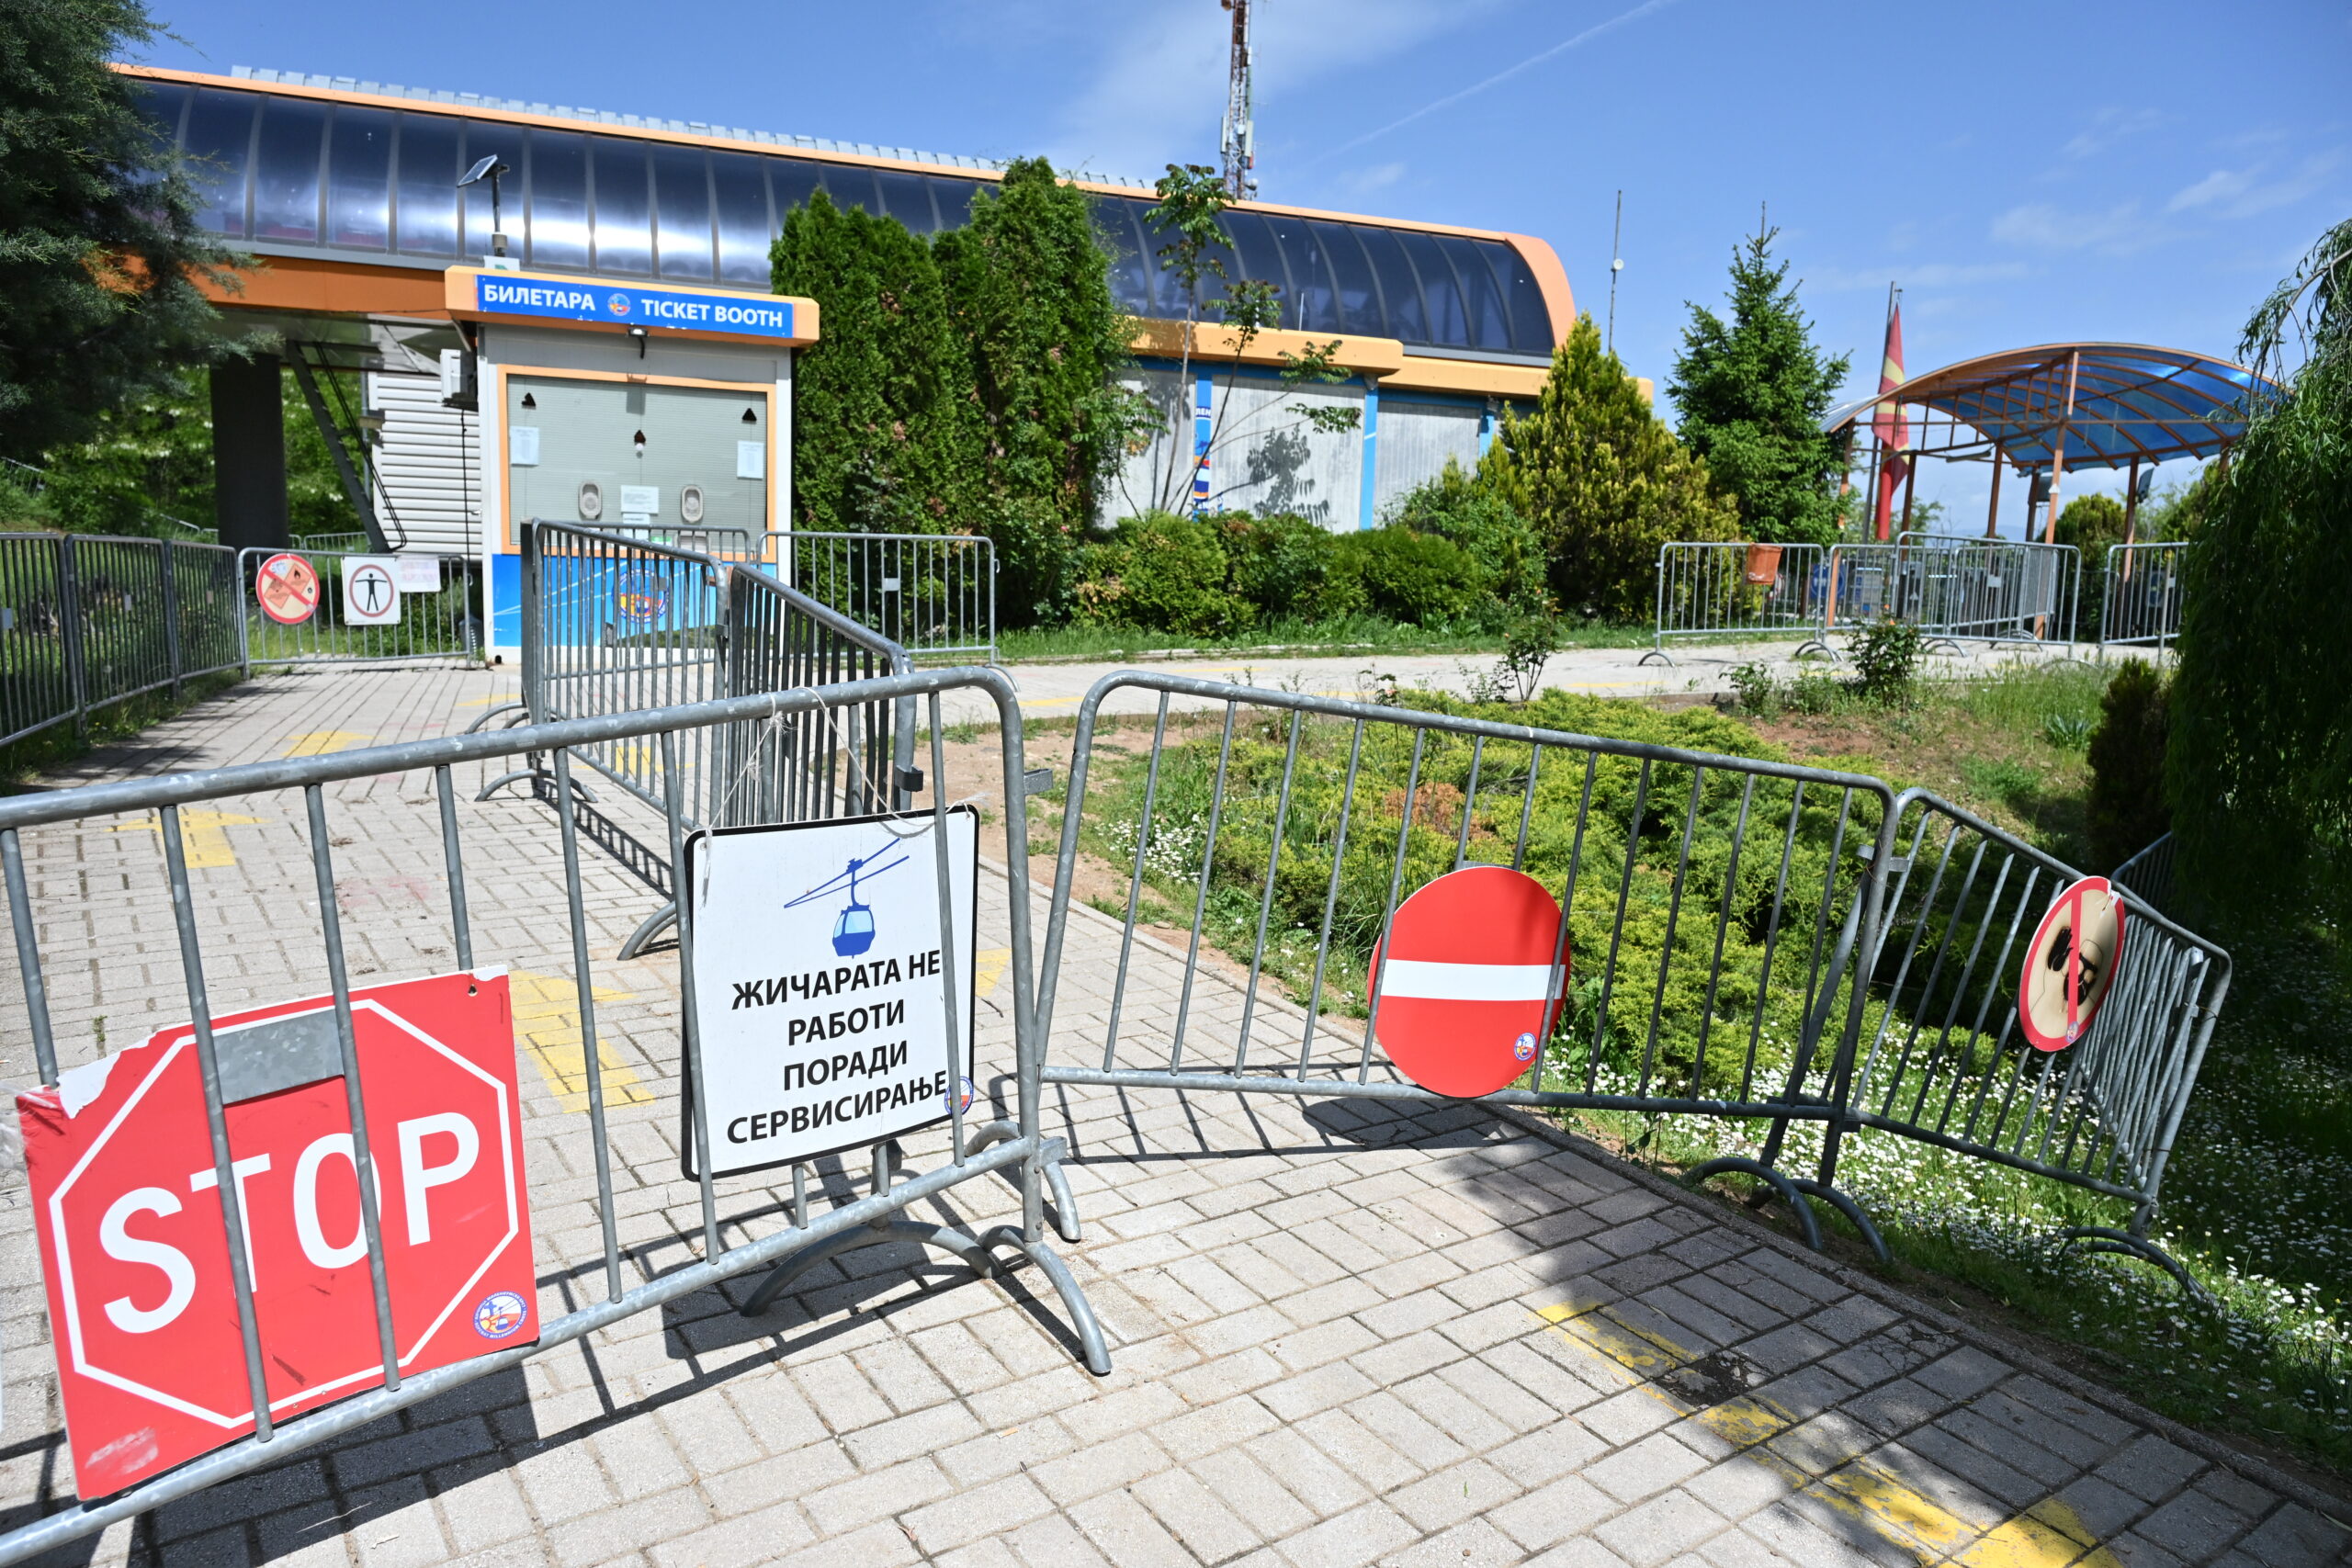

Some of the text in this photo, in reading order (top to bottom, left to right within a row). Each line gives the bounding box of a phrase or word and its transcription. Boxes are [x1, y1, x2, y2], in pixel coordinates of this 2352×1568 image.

[484, 284, 596, 311] БИЛЕТАРА
[641, 299, 783, 328] TICKET BOOTH
[731, 949, 941, 1010] ЖИЧАРАТА НЕ
[788, 999, 904, 1046] РАБОТИ
[784, 1040, 908, 1091] ПОРАДИ
[727, 1070, 946, 1145] СЕРВИСИРАЊЕ
[99, 1111, 481, 1334] STOP
